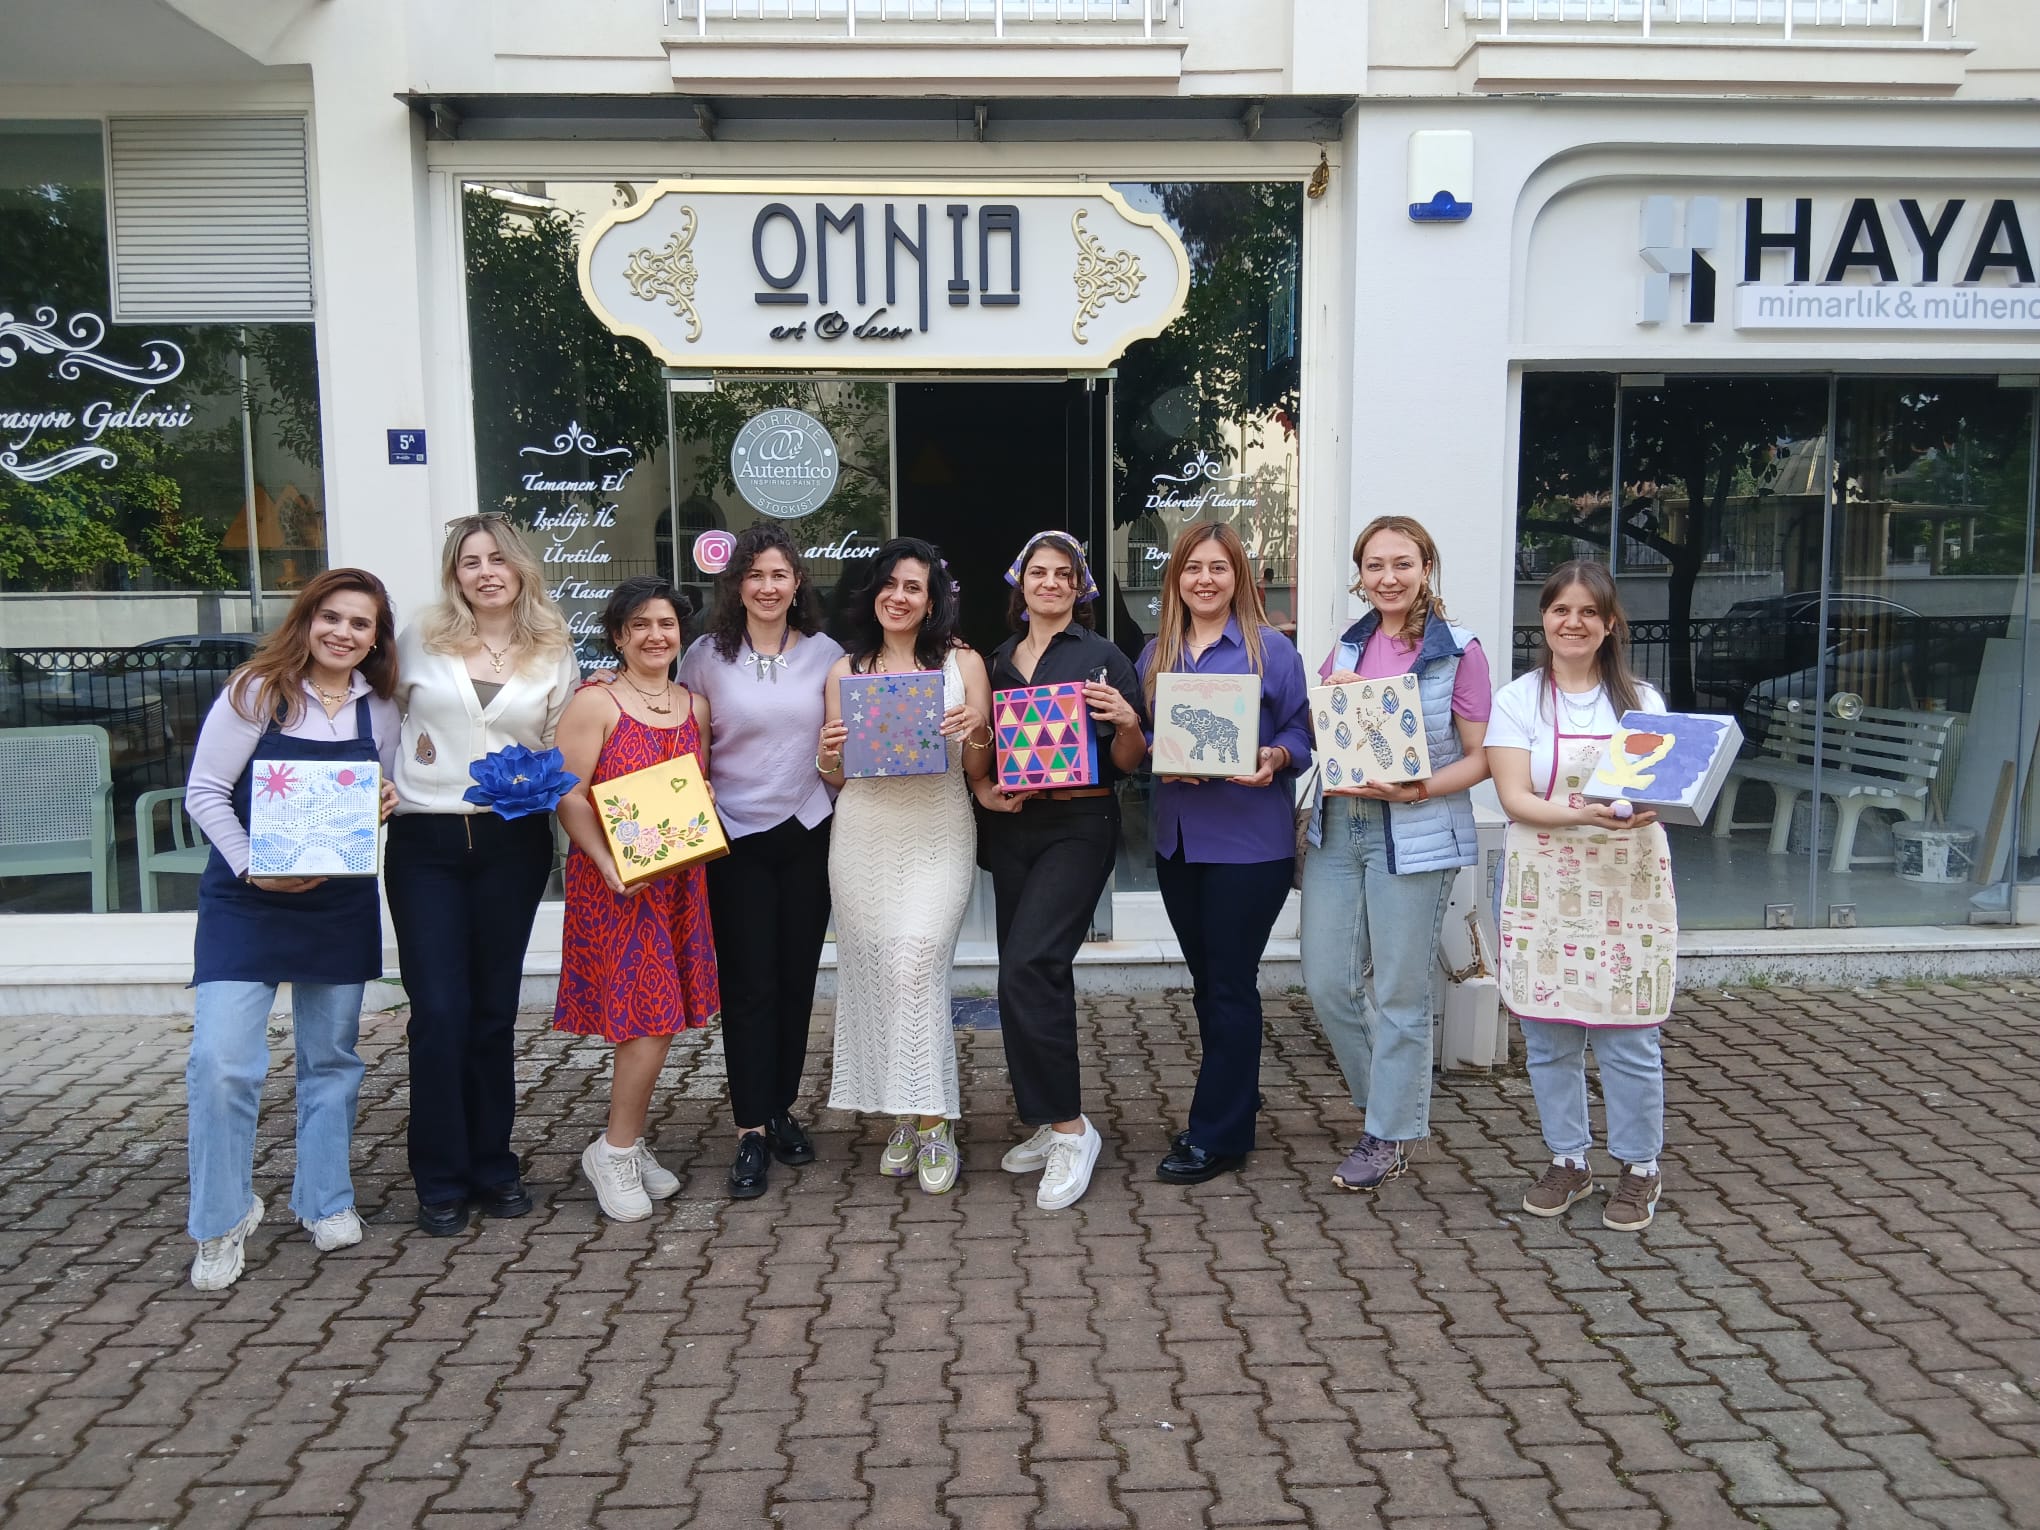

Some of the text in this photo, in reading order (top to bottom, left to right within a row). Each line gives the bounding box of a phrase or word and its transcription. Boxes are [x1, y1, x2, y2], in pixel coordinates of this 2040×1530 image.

[1744, 198, 2036, 283] HAYA
[752, 202, 1021, 332] OMNIA
[769, 320, 807, 340] art
[852, 307, 913, 340] decor
[82, 389, 193, 441] Galerisi
[522, 468, 634, 492] Tamamen El
[757, 498, 814, 514] STOCKIST
[1145, 486, 1216, 522] Dekoratif
[543, 540, 612, 563] Üretilen
[568, 580, 614, 599] Tasar
[567, 612, 605, 647] bilya
